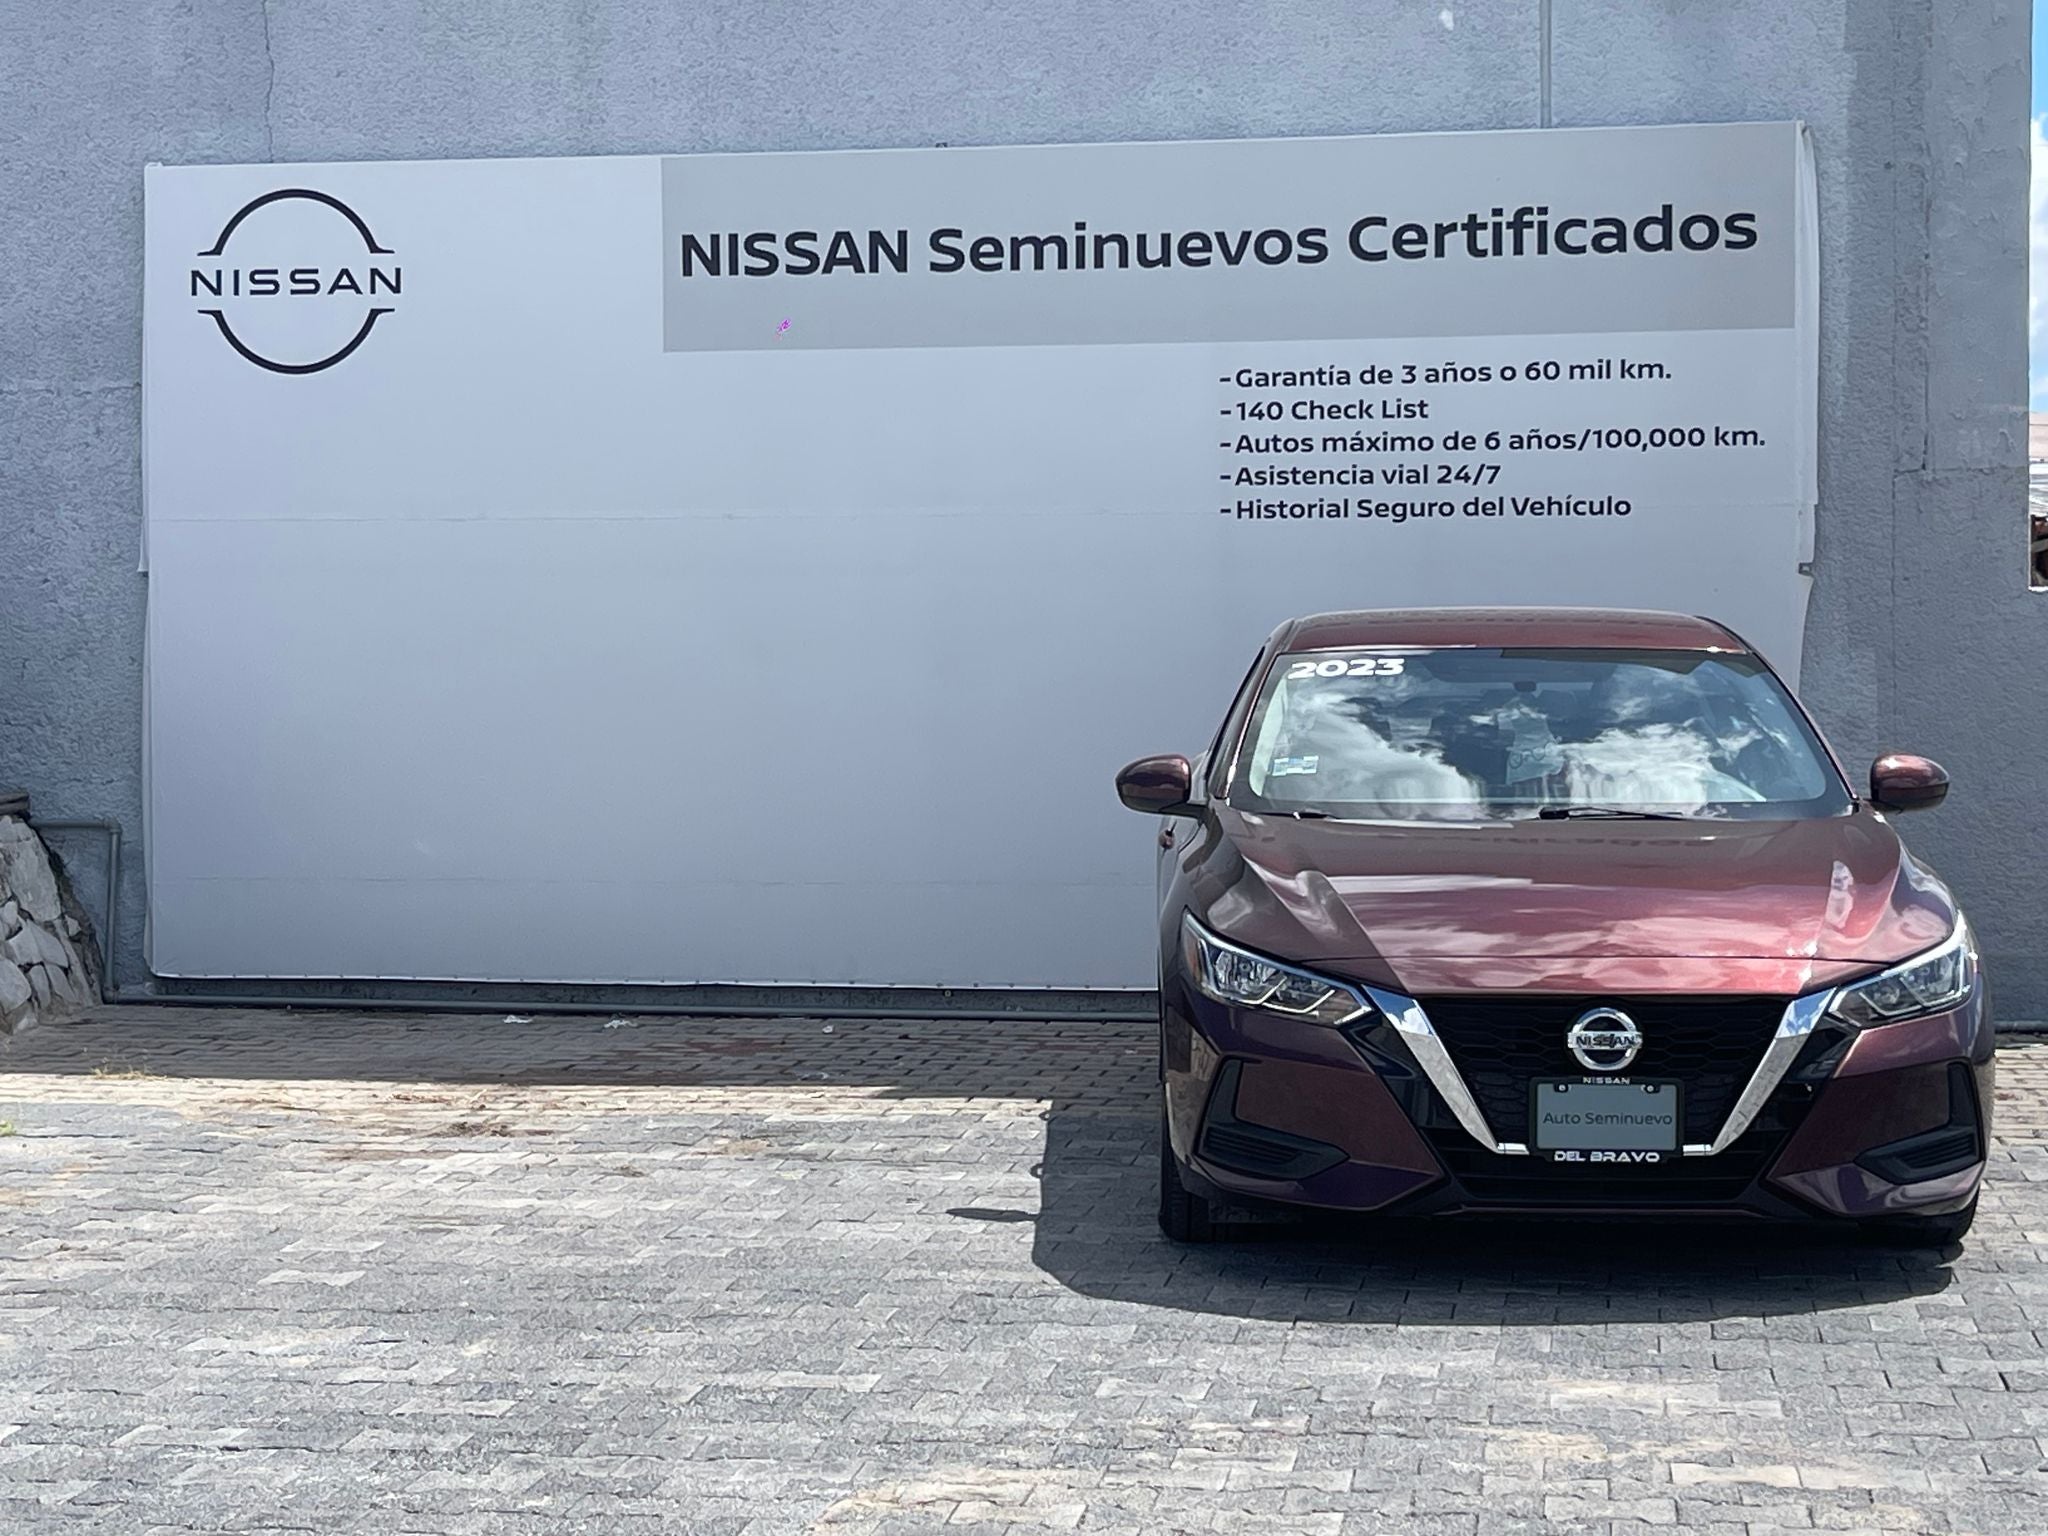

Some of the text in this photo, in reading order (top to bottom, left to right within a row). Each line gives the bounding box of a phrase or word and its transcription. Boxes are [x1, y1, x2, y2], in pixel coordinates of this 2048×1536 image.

[682, 204, 1757, 277] NISSAN Seminuevos Certificados
[191, 267, 401, 297] NISSAN
[1360, 364, 1393, 385] de
[1401, 365, 1417, 385] 3
[1425, 362, 1492, 383] años
[1500, 366, 1517, 382] o
[1525, 361, 1561, 381] 60
[1569, 359, 1612, 380] mil
[1621, 359, 1672, 380] km.
[1292, 399, 1374, 421] Check
[1382, 398, 1429, 419] List
[1322, 431, 1434, 452] máximo
[1443, 431, 1476, 451] de
[1485, 431, 1501, 450] 6
[1509, 428, 1706, 453] años/100,000
[1715, 426, 1766, 447] km.
[1382, 464, 1429, 485] vial
[1437, 463, 1500, 486] 24/7
[1357, 499, 1455, 524] Seguro
[1463, 496, 1504, 517] del
[1511, 495, 1632, 517] Vehículo
[1287, 658, 1405, 680] 2023
[1575, 1034, 1636, 1049] NISSAN
[1583, 1077, 1631, 1085] NISSAN
[1542, 1112, 1673, 1126] Auto Seminuevo
[1553, 1150, 1660, 1163] DEL BRAVO
